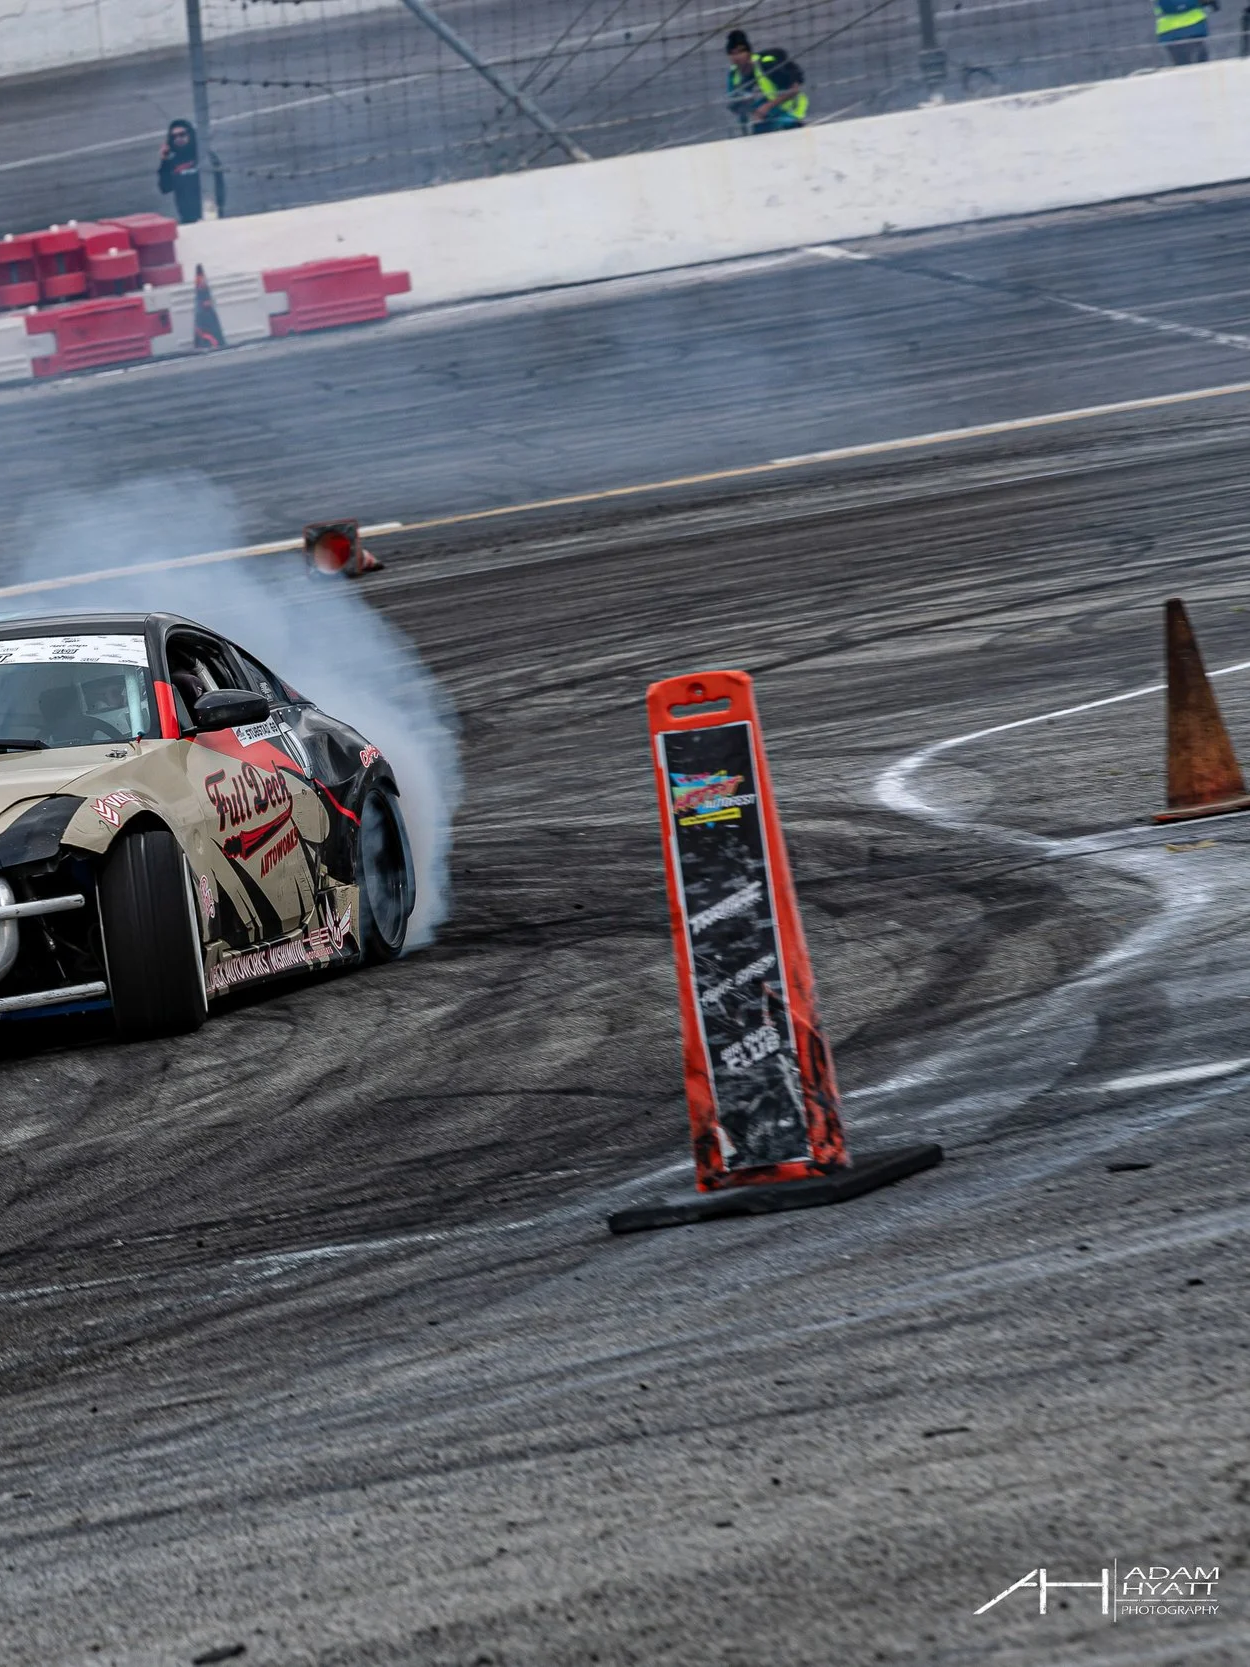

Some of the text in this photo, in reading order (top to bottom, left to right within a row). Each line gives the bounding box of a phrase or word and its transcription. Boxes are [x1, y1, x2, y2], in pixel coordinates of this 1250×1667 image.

[204, 760, 292, 833] Full Deck
[260, 825, 300, 879] AUTOWORKS
